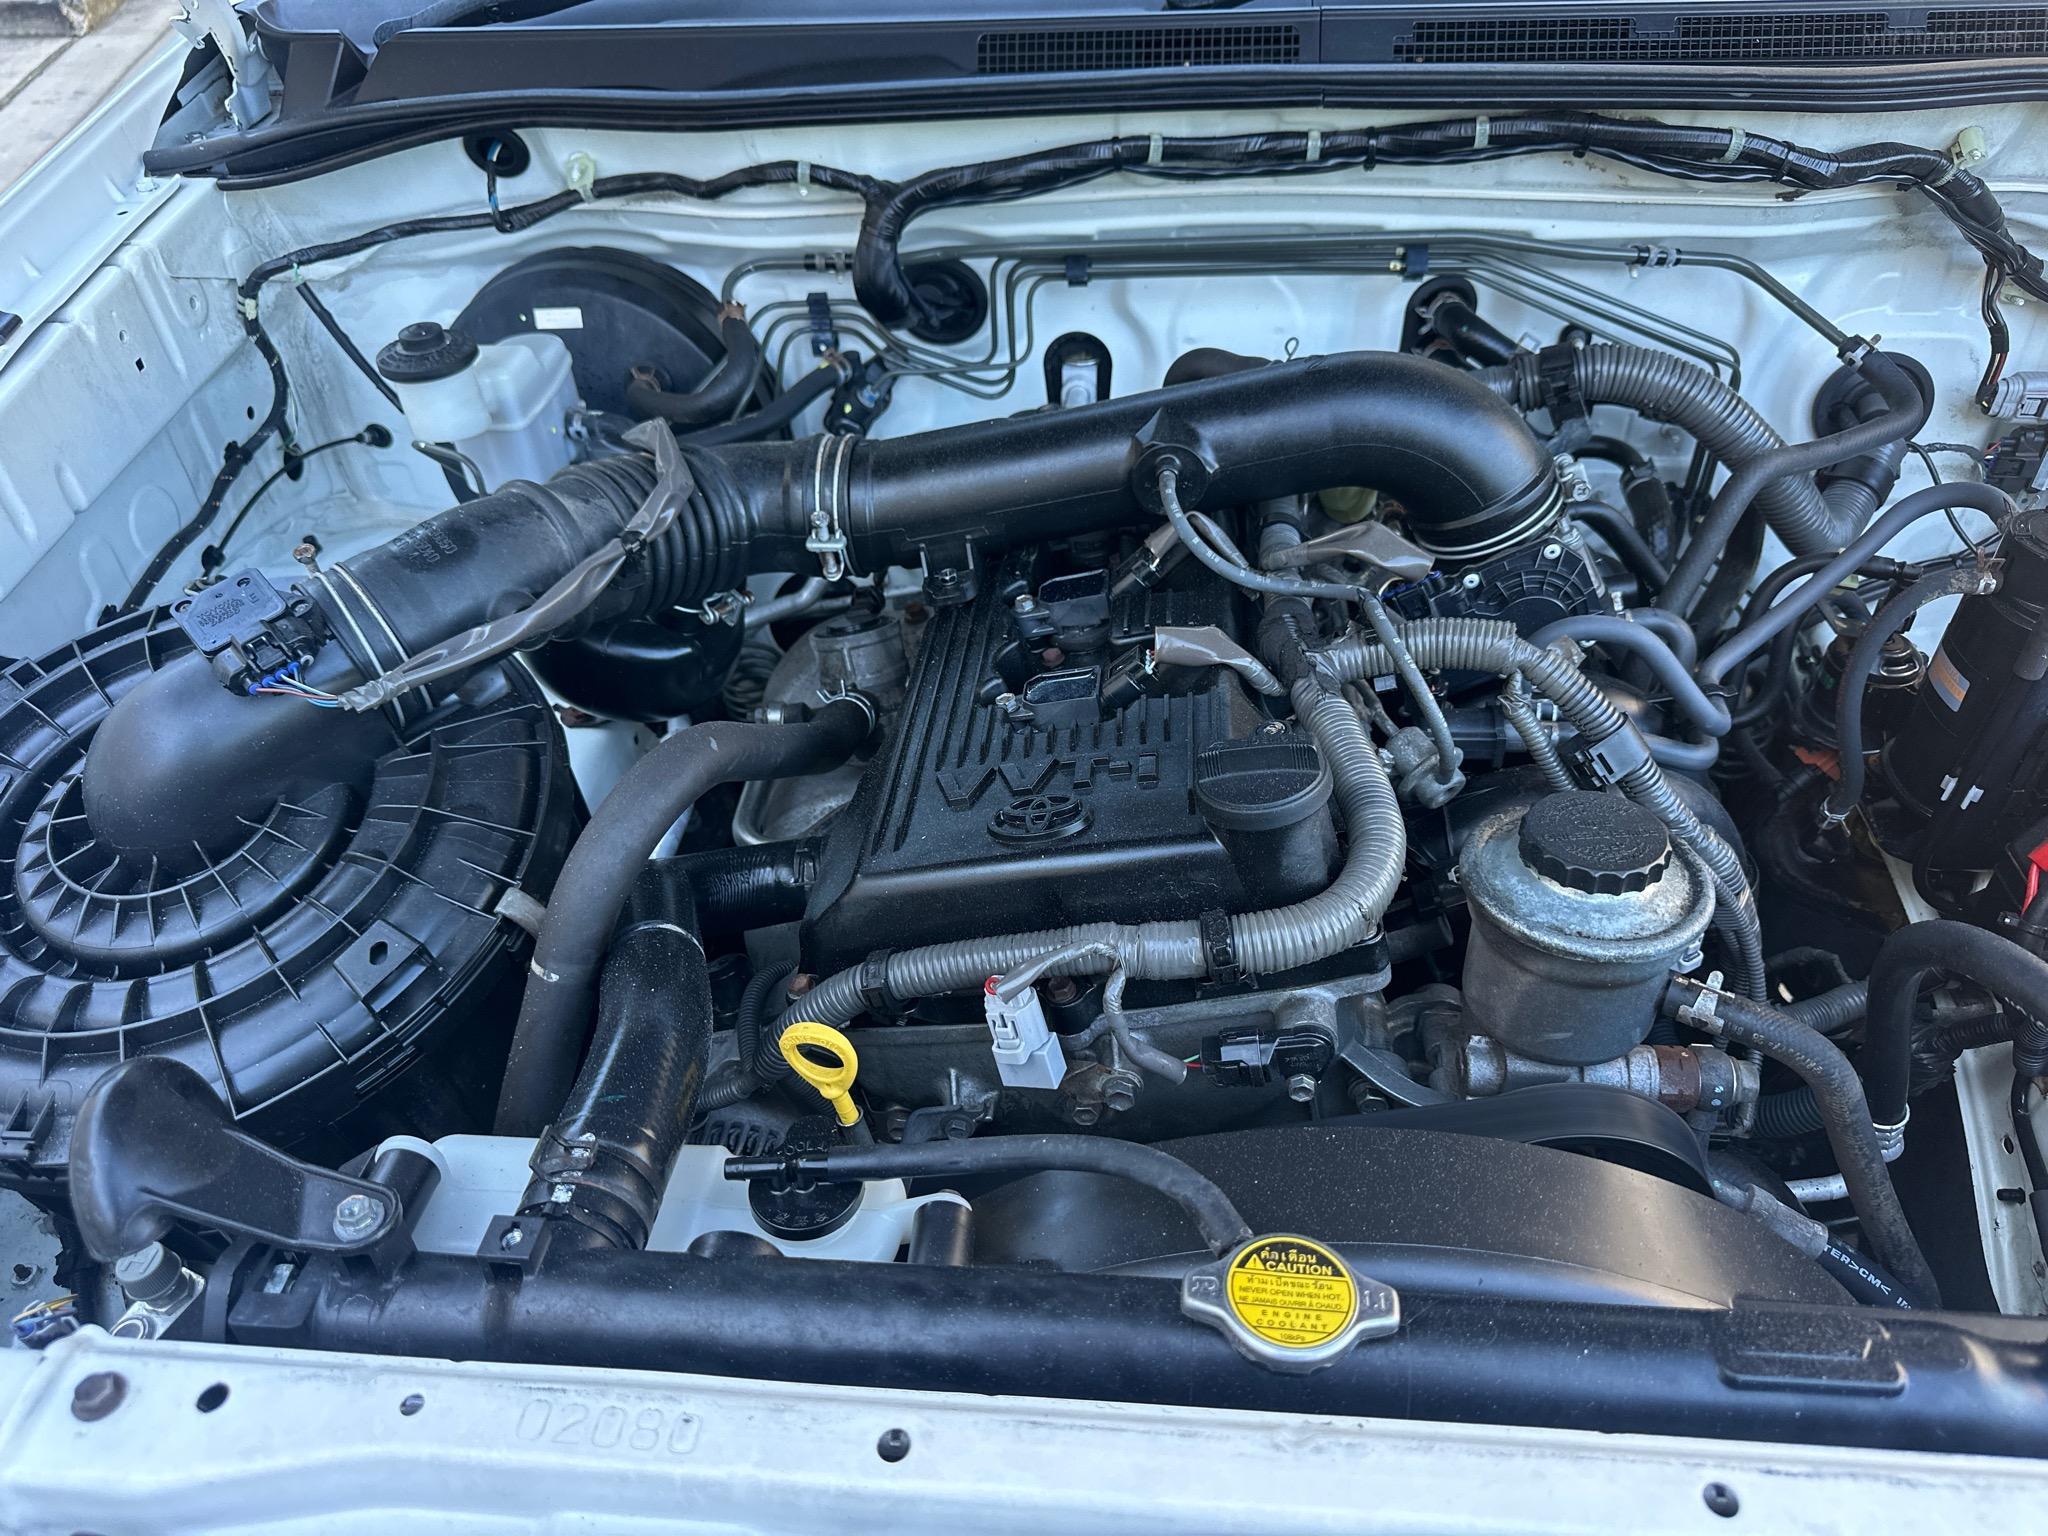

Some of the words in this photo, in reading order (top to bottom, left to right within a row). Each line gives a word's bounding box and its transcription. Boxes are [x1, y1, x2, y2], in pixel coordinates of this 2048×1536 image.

[1265, 1260, 1332, 1276] CAUTION
[1239, 1285, 1267, 1294] NEVER
[1269, 1288, 1294, 1297] OPEN
[1295, 1290, 1321, 1299] WHEN
[1261, 1309, 1323, 1321] ENGINE
[1255, 1318, 1328, 1330] COOLANT
[516, 1399, 703, 1455] 02080
